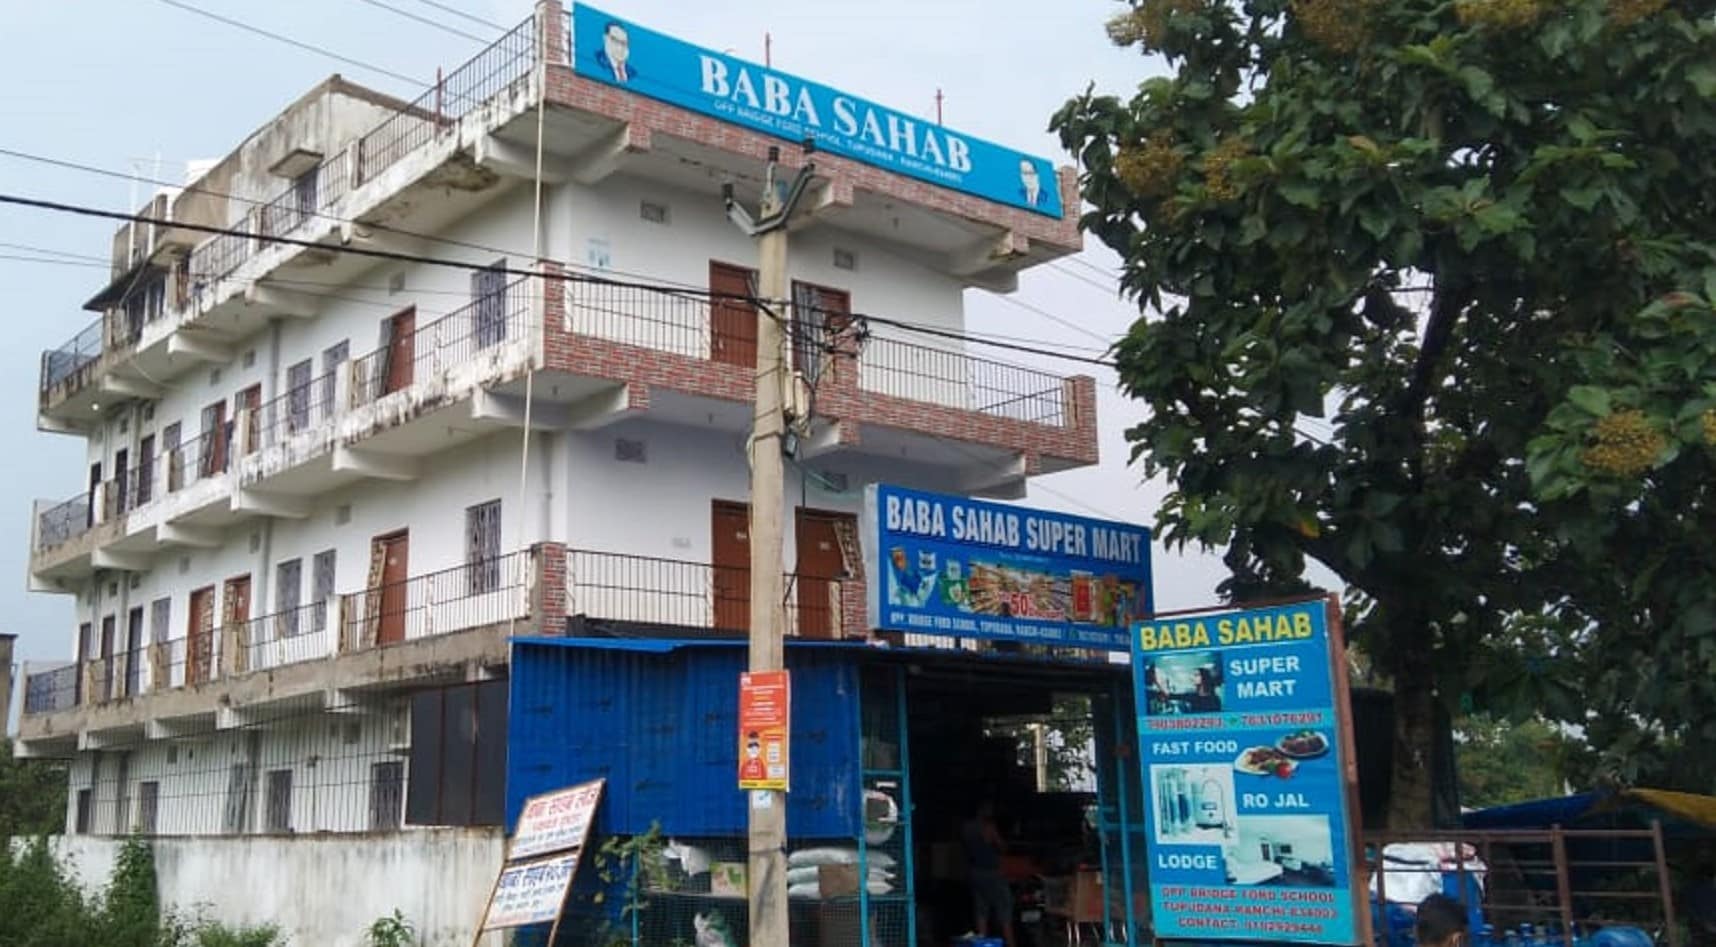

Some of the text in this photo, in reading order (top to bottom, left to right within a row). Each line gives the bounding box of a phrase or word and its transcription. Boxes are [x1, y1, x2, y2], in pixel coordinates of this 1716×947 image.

[700, 55, 973, 174] BABA SAHAB
[886, 495, 1142, 564] BABA SAHAB SUPER MART
[1141, 622, 1210, 650] BABA
[1218, 612, 1312, 644] SAHAB
[1229, 655, 1301, 676] SUPER
[1237, 680, 1296, 698] MART
[1152, 739, 1238, 755] FAST FOOD
[1243, 793, 1310, 808] RO JAL
[1158, 854, 1218, 870] LODGE
[1281, 891, 1335, 903] SCHOOL
